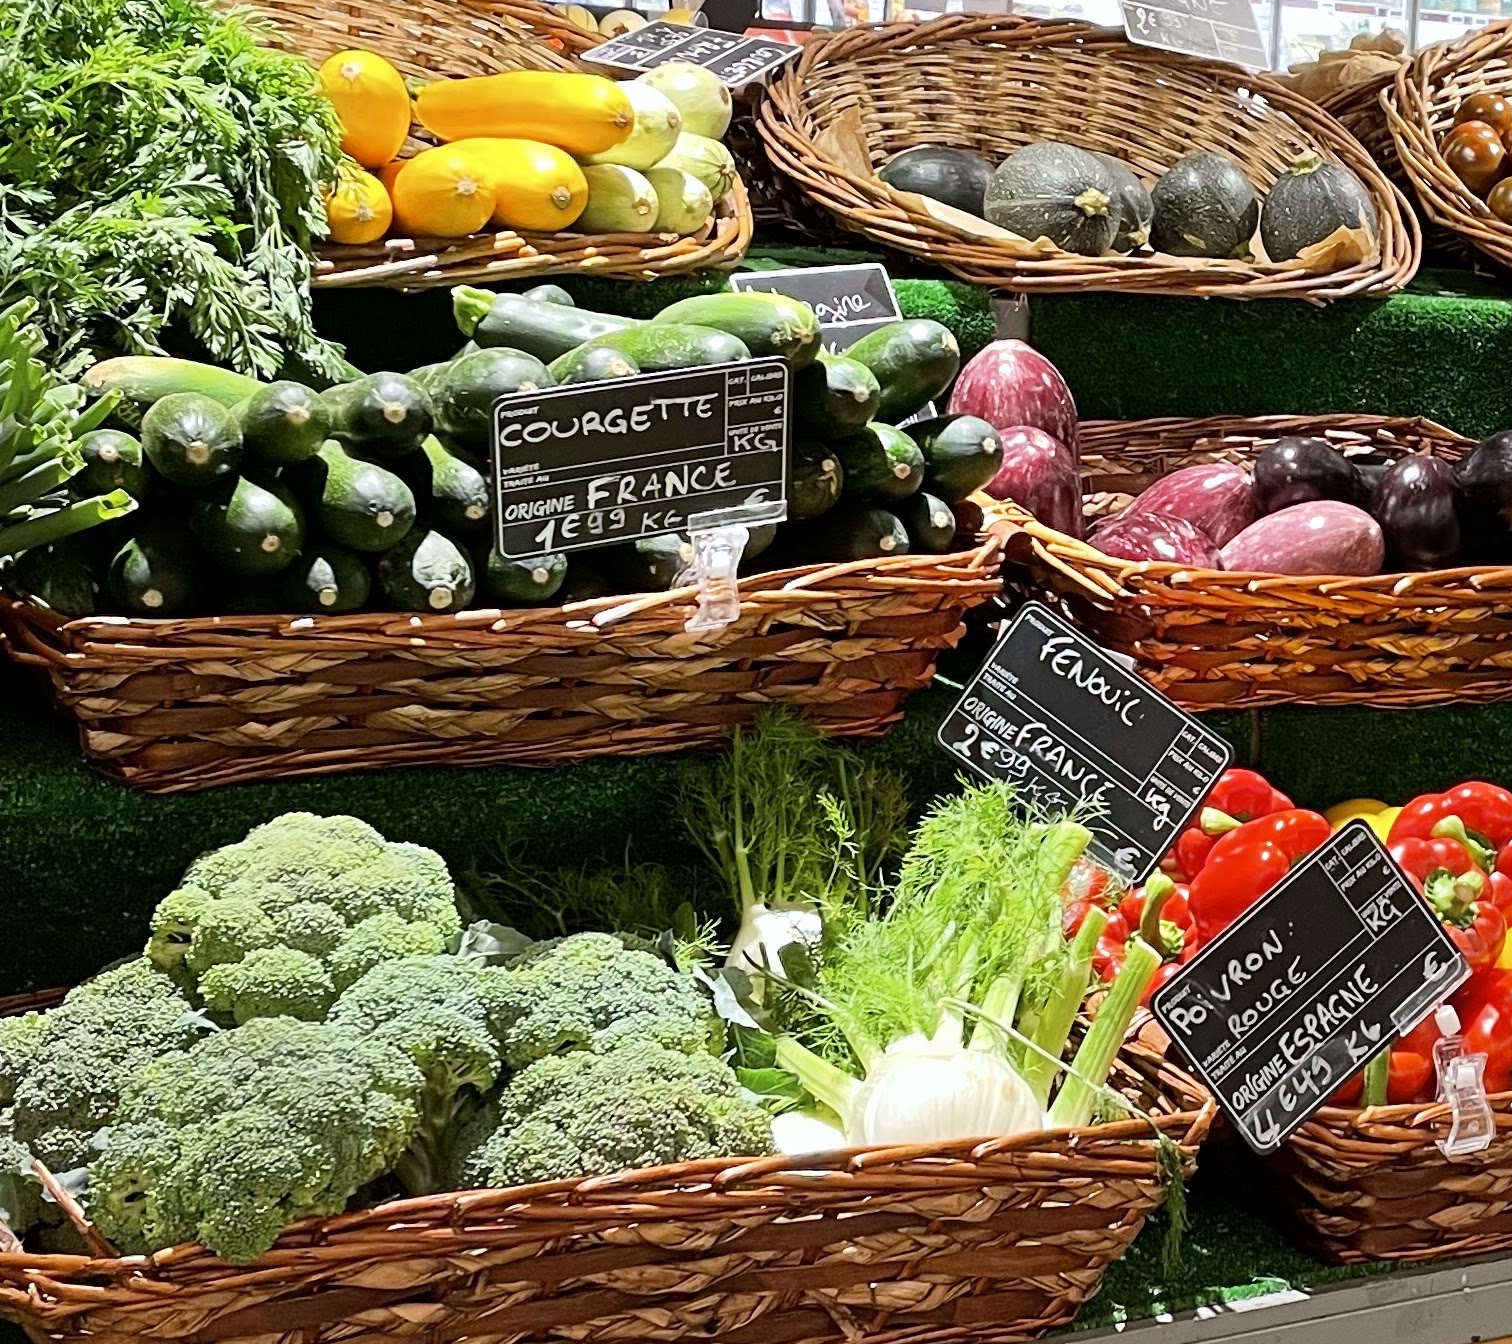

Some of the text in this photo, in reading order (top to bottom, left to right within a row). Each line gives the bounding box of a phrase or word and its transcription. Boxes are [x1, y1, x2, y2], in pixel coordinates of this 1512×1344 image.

[499, 392, 720, 447] COURGETTE
[733, 432, 779, 452] KG
[504, 462, 737, 521] ORIGINE FRANCE
[963, 696, 1019, 741] ORIGINE
[1014, 722, 1115, 807] FRANCE
[1227, 955, 1309, 1040] ROUGE
[1232, 963, 1380, 1111] ORIGINE ESPAGNE
